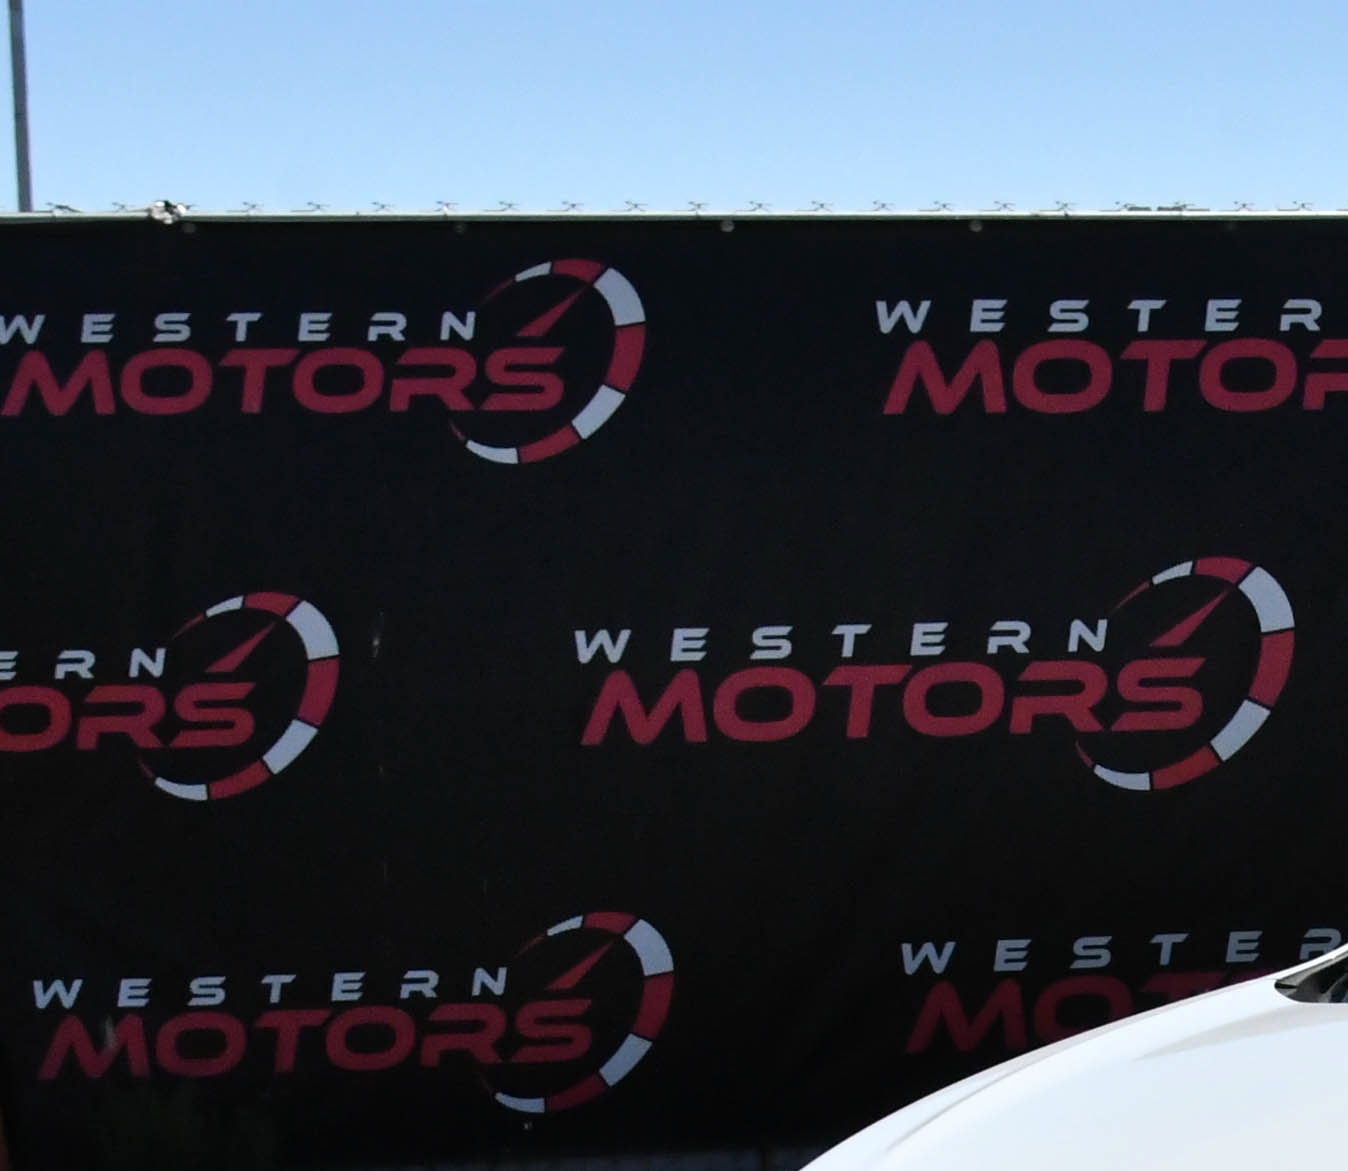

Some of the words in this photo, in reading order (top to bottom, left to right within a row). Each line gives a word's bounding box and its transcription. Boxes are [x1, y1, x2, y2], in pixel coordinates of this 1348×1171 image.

[0, 311, 477, 344] WESTERN
[0, 346, 566, 417] MOTORS
[574, 620, 1108, 663] WESTERN
[581, 657, 1207, 746] MOTORS
[33, 967, 508, 1010] WESTERN
[38, 999, 593, 1080] MOTORS
